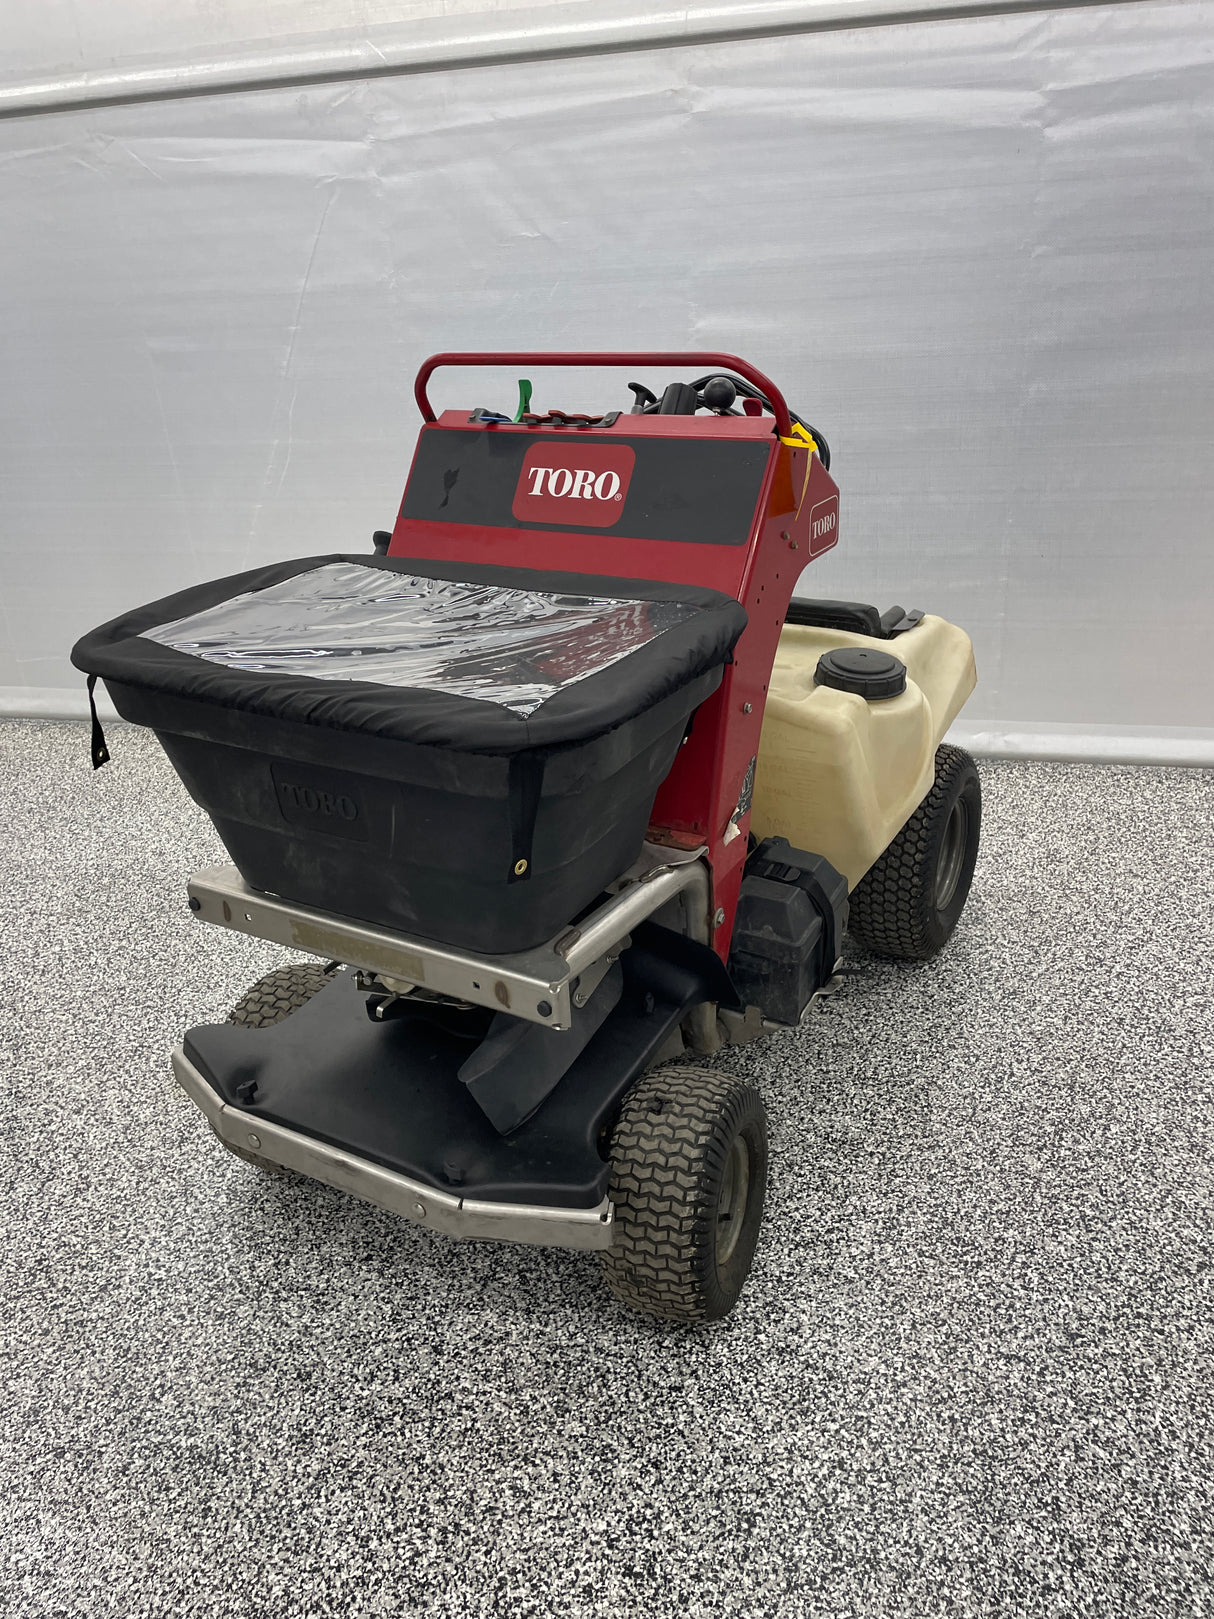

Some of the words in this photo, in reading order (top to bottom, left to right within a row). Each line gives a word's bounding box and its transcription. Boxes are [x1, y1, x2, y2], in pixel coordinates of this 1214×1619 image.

[528, 467, 620, 500] TORO
[812, 512, 836, 539] TORO
[281, 782, 359, 821] TORO
